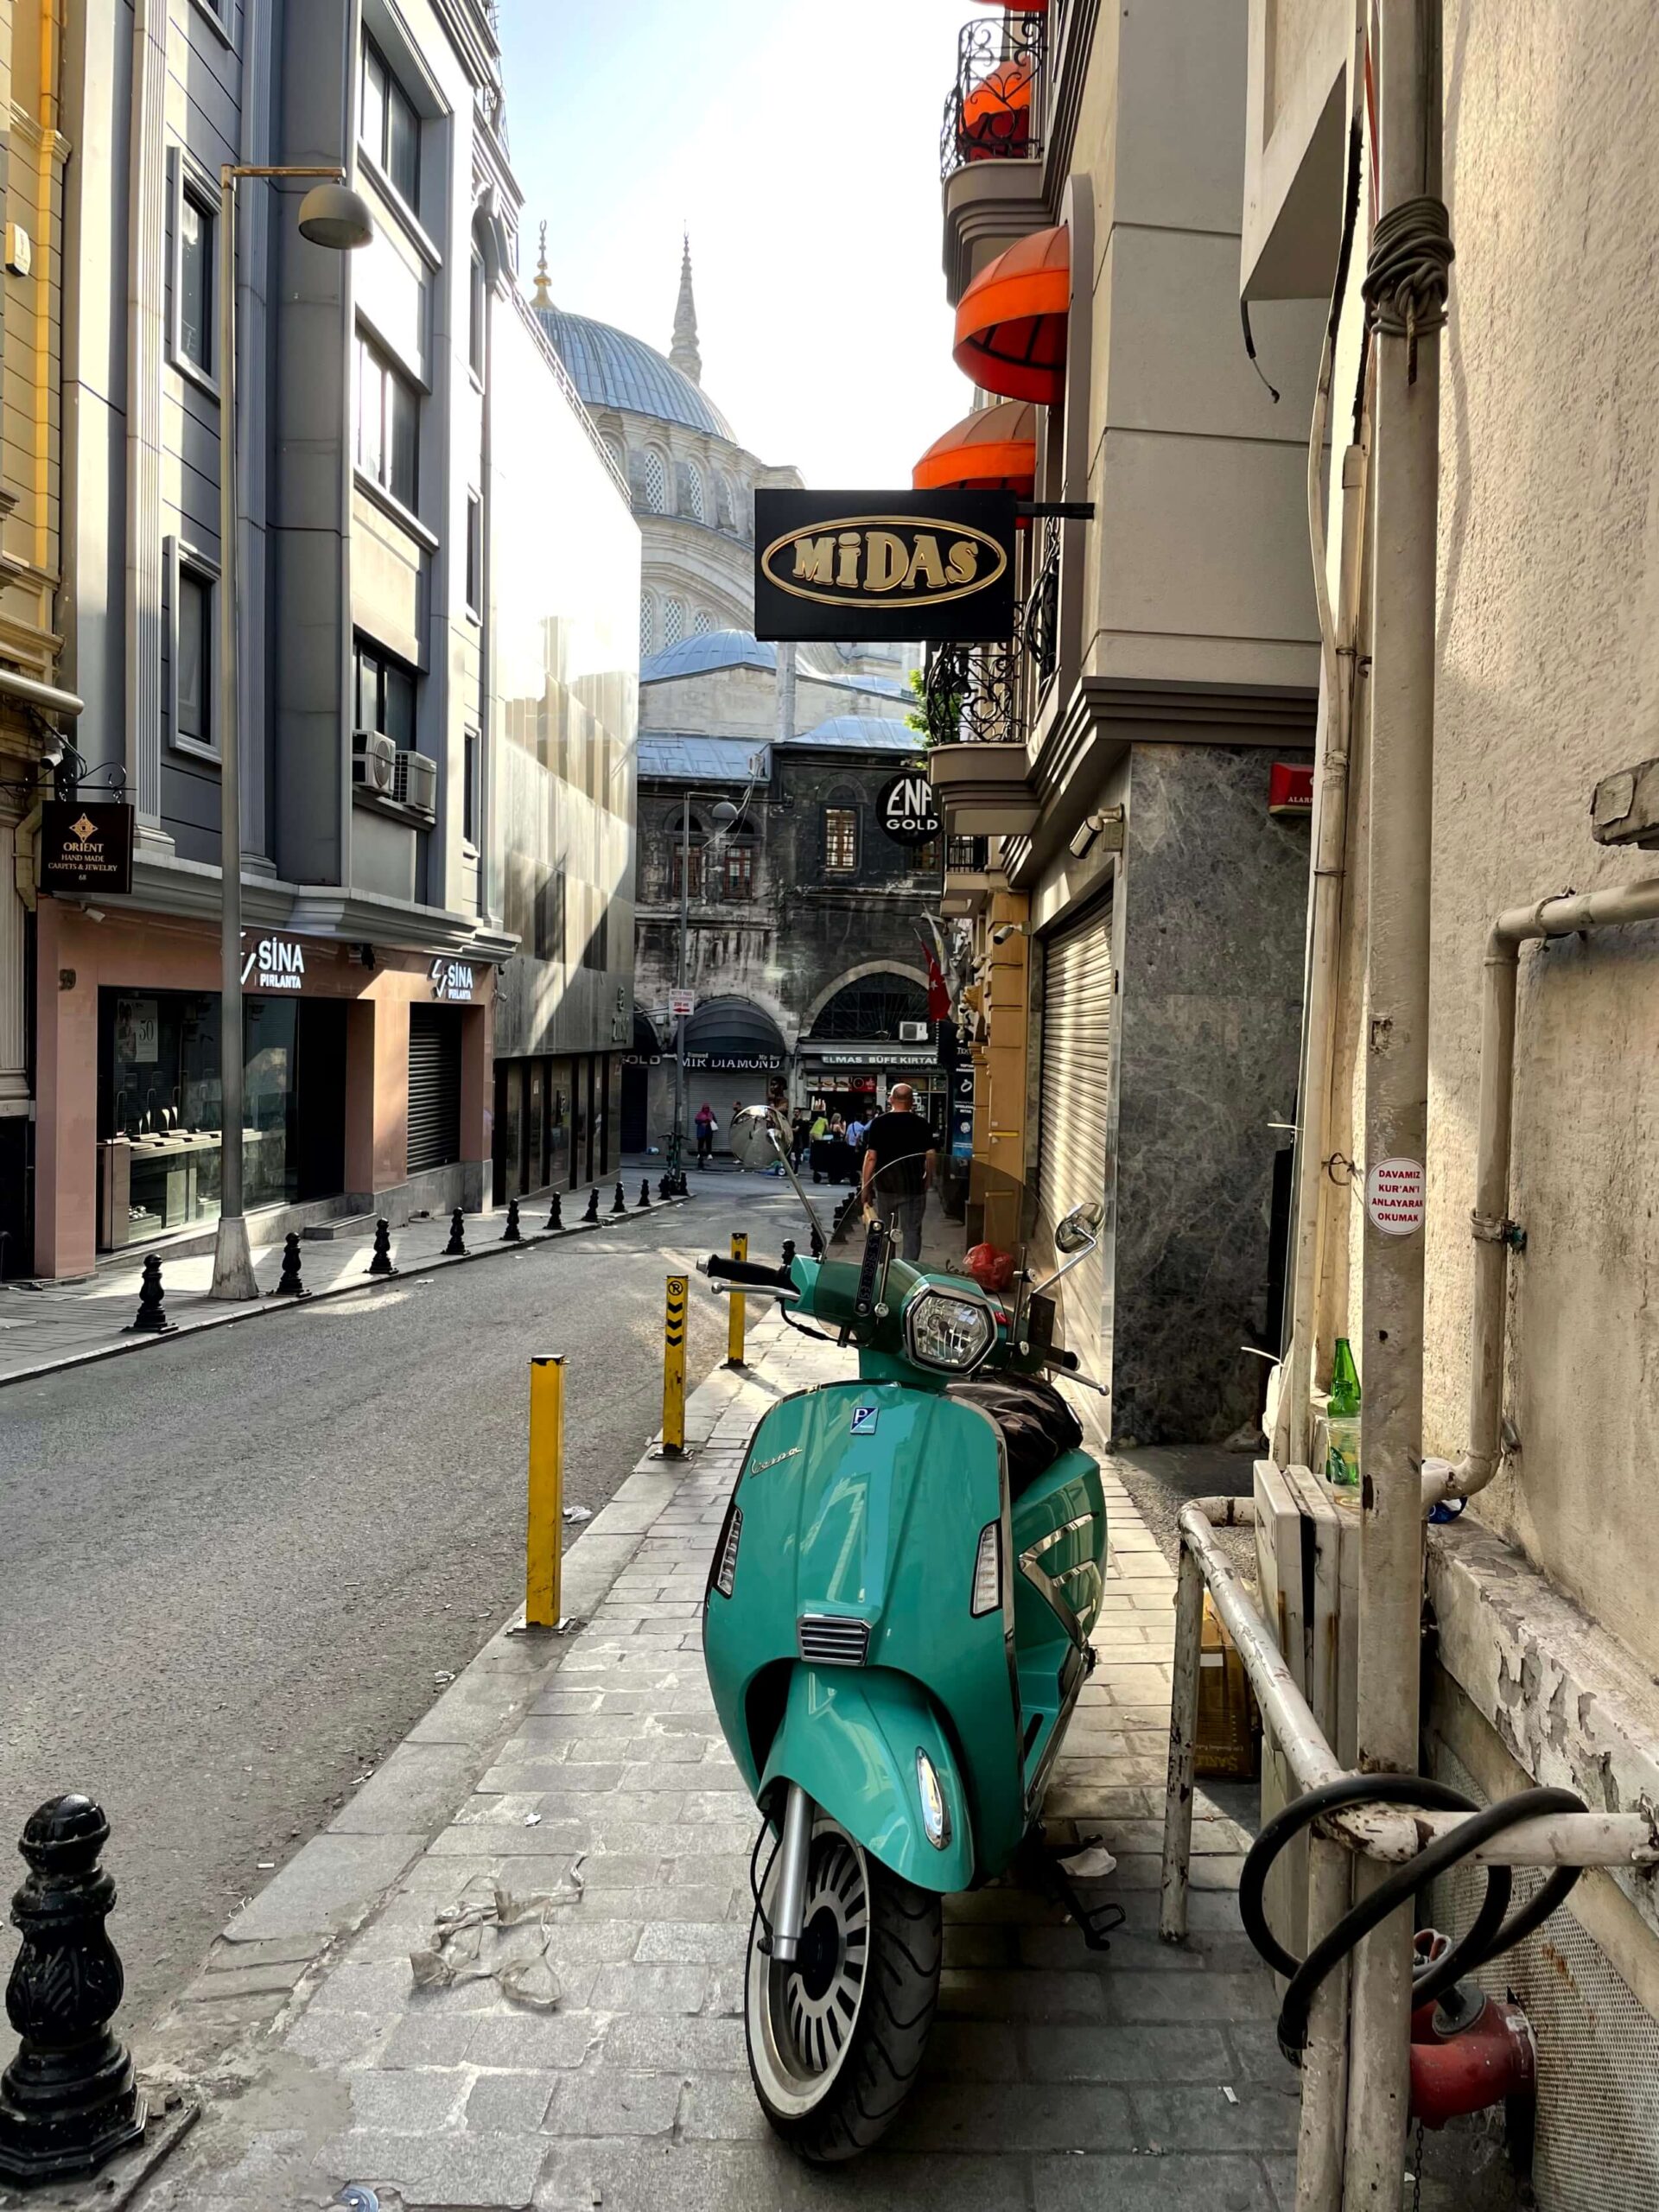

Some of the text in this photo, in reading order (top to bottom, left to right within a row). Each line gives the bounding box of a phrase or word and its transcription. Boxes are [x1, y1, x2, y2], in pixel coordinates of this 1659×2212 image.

[886, 818, 938, 830] GOLD
[63, 842, 105, 853] ORIENT
[258, 937, 305, 974] SİNA
[448, 962, 474, 989] SİNA
[711, 1059, 780, 1069] DIAMOND
[868, 1055, 898, 1064] BÜFE
[1379, 1170, 1421, 1179] DAVAMIZ
[1378, 1213, 1418, 1222] OKUMAK
